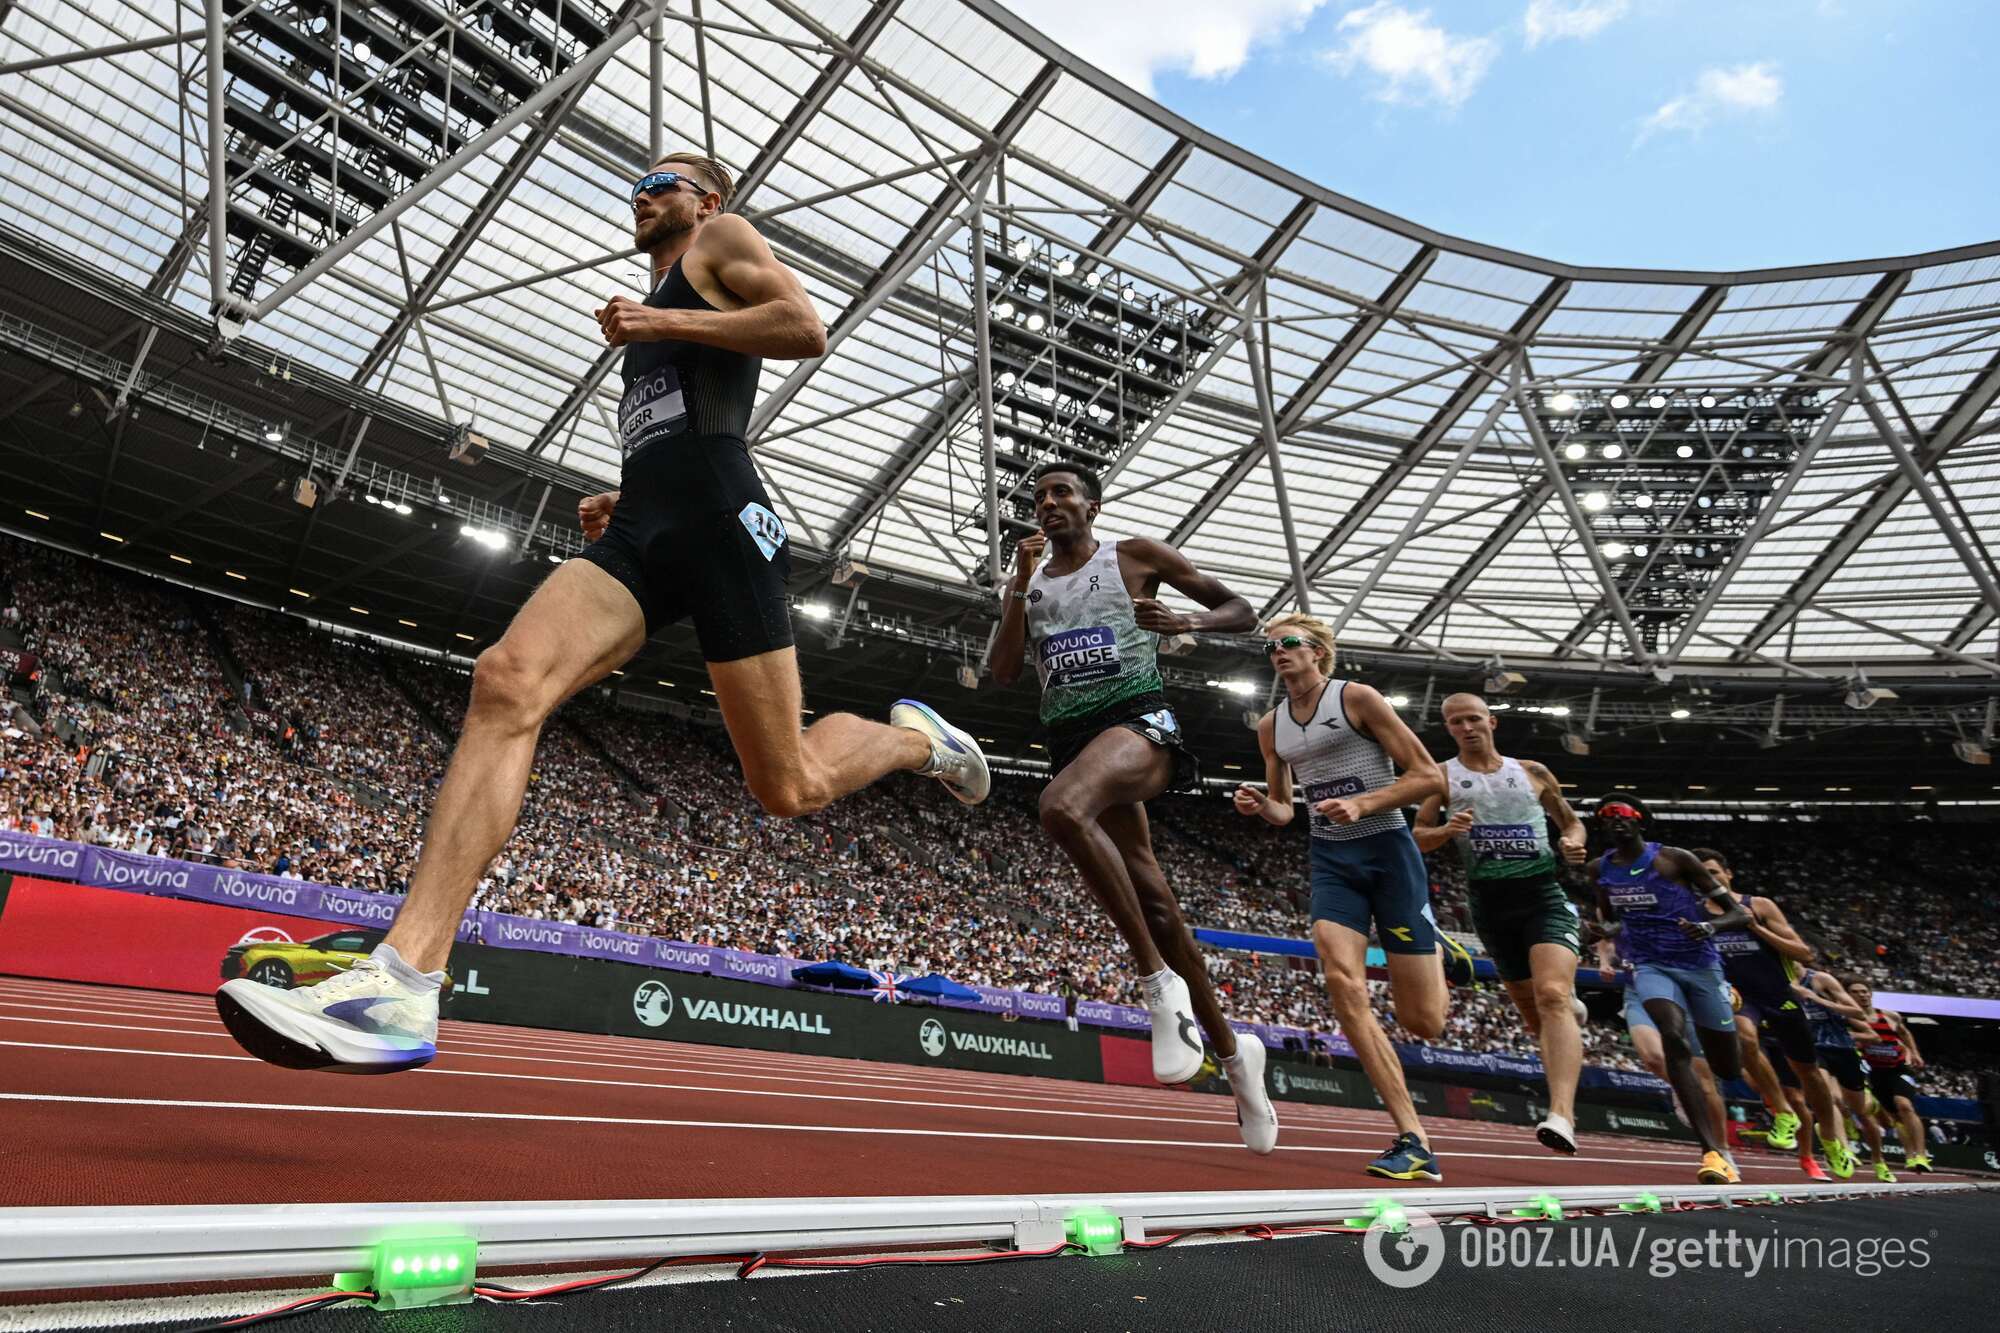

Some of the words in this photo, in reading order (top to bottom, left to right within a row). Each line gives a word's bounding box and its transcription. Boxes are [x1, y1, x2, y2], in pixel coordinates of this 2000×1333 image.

[621, 376, 667, 420] ovuna
[624, 408, 653, 436] KERR
[634, 427, 670, 448] VAUXHALL
[755, 511, 781, 541] 10
[0, 841, 78, 868] ovuna
[1475, 840, 1535, 851] FARKEN
[94, 857, 189, 889] Novuna
[213, 872, 297, 905] Novuna
[319, 893, 394, 922] Novuna
[499, 922, 562, 946] Novuna
[580, 931, 639, 956] Novuna
[655, 943, 710, 967] Novuna
[725, 953, 777, 978] Novuna
[682, 997, 831, 1036] VAUXHALL
[1017, 994, 1061, 1014] Novuna
[1122, 1010, 1152, 1026] Novu
[951, 1031, 1052, 1060] VAUXHALL
[1289, 1075, 1343, 1094] VAUXHALL
